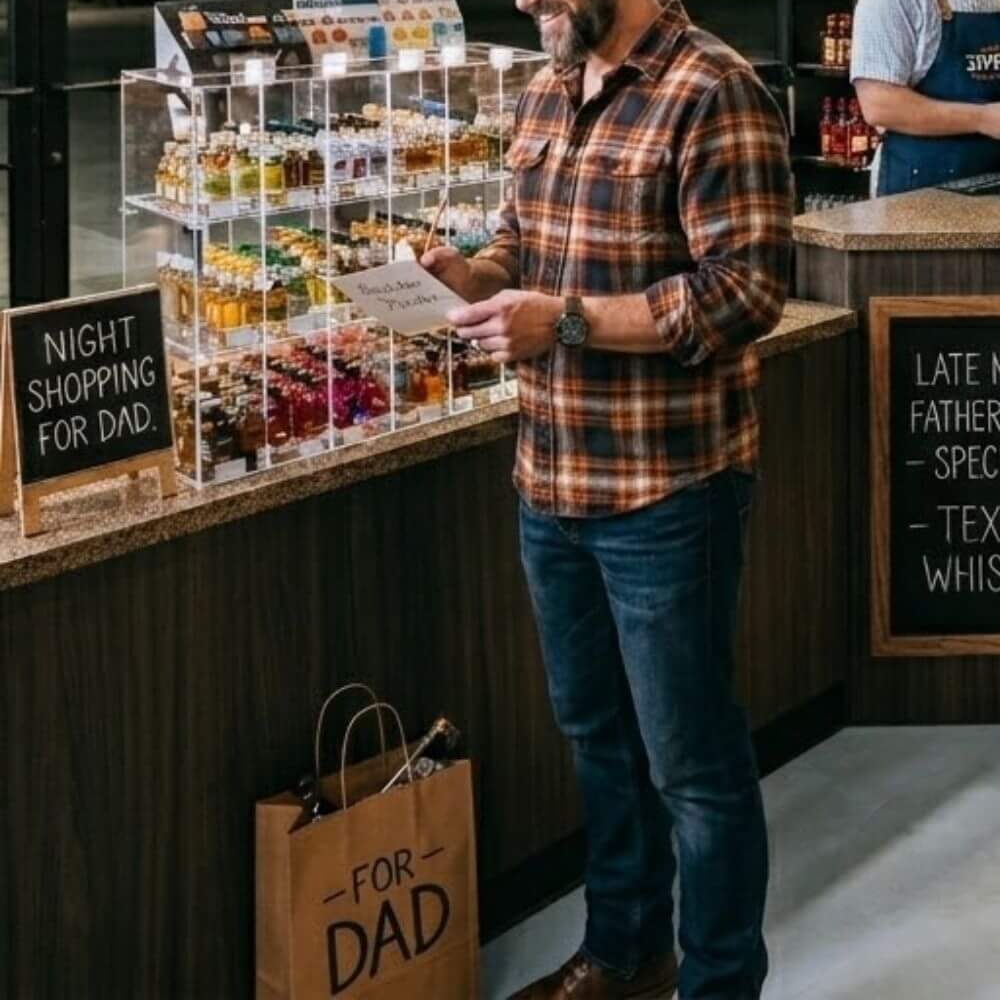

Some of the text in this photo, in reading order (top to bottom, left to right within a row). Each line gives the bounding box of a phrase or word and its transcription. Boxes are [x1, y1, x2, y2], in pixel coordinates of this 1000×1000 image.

[44, 316, 135, 365] NIGHT
[28, 356, 155, 413] SHOPPING
[916, 352, 981, 386] LATE
[38, 402, 157, 456] FOR DAD.
[352, 848, 415, 904] FOR
[327, 883, 450, 995] DAD
